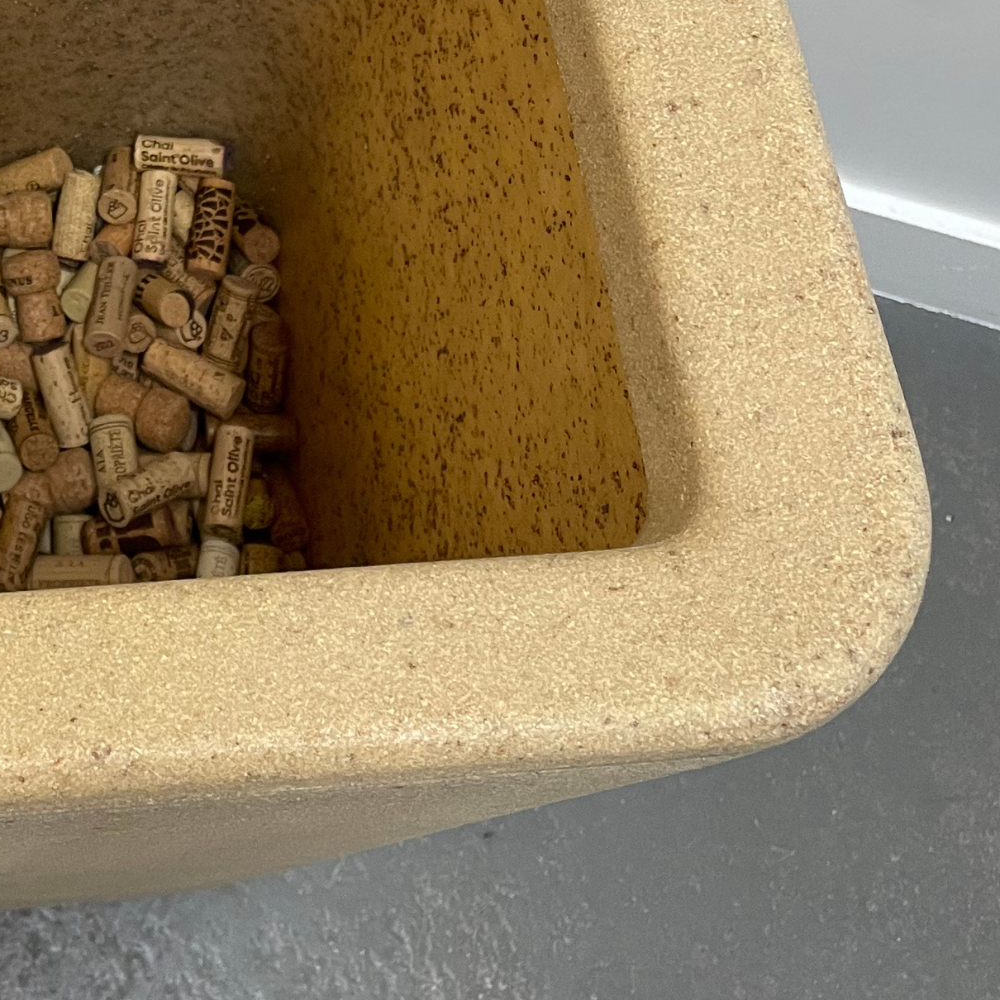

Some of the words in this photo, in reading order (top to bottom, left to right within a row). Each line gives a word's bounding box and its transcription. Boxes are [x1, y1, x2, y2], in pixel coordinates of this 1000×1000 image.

[141, 139, 174, 150] Chai
[141, 151, 177, 164] Saint
[178, 154, 214, 168] Olive
[151, 179, 165, 213] Olive
[134, 220, 146, 253] Chai
[228, 436, 243, 472] Olive
[211, 480, 223, 514] Chai
[222, 477, 237, 516] Saint
